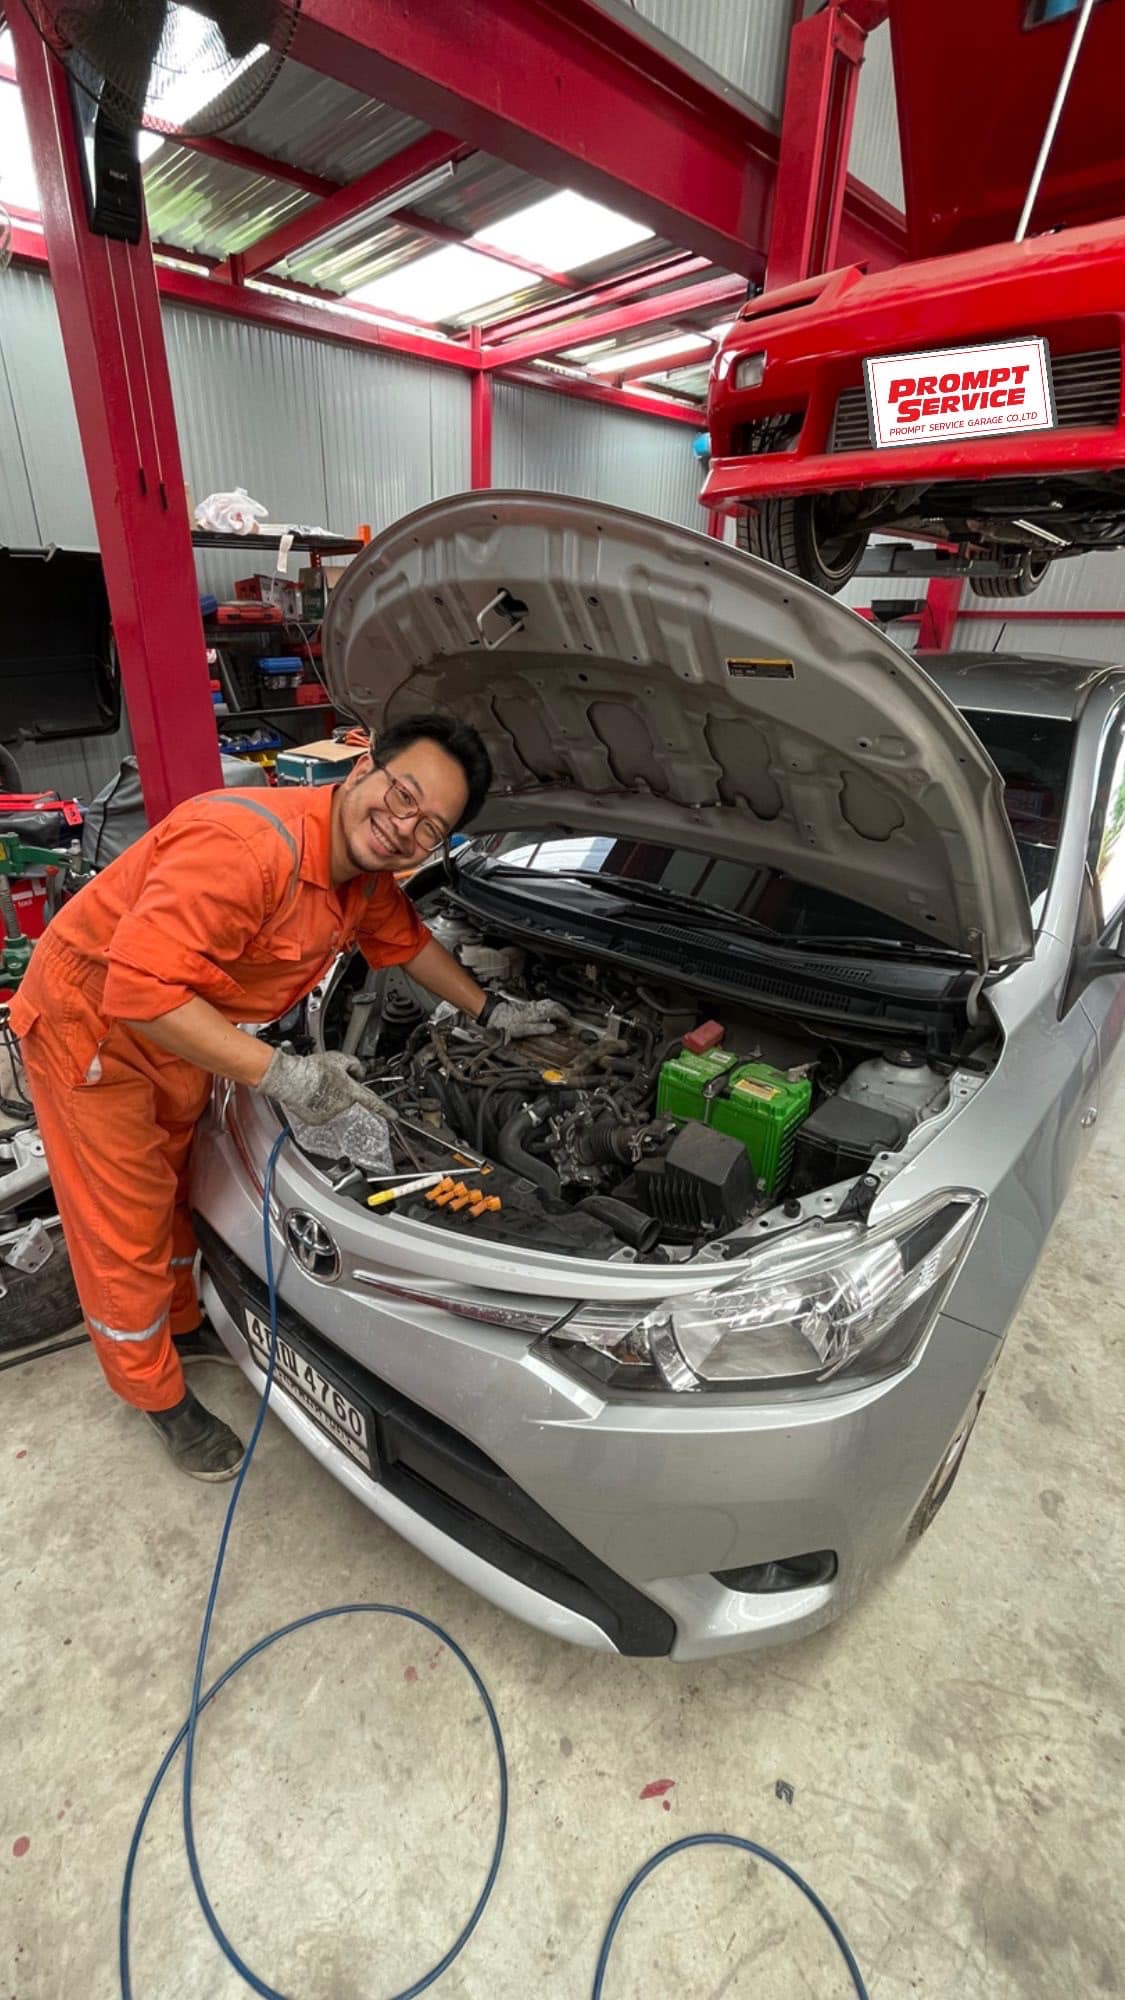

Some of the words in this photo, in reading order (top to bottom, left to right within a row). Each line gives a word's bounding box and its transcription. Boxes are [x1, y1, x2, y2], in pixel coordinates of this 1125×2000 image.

[888, 365, 1030, 404] PROMPT
[896, 388, 1026, 424] SERVICE
[889, 425, 926, 437] PROMPT
[929, 420, 965, 432] SERVICE
[968, 416, 1003, 427] GARAGE
[304, 1366, 362, 1437] 4760
